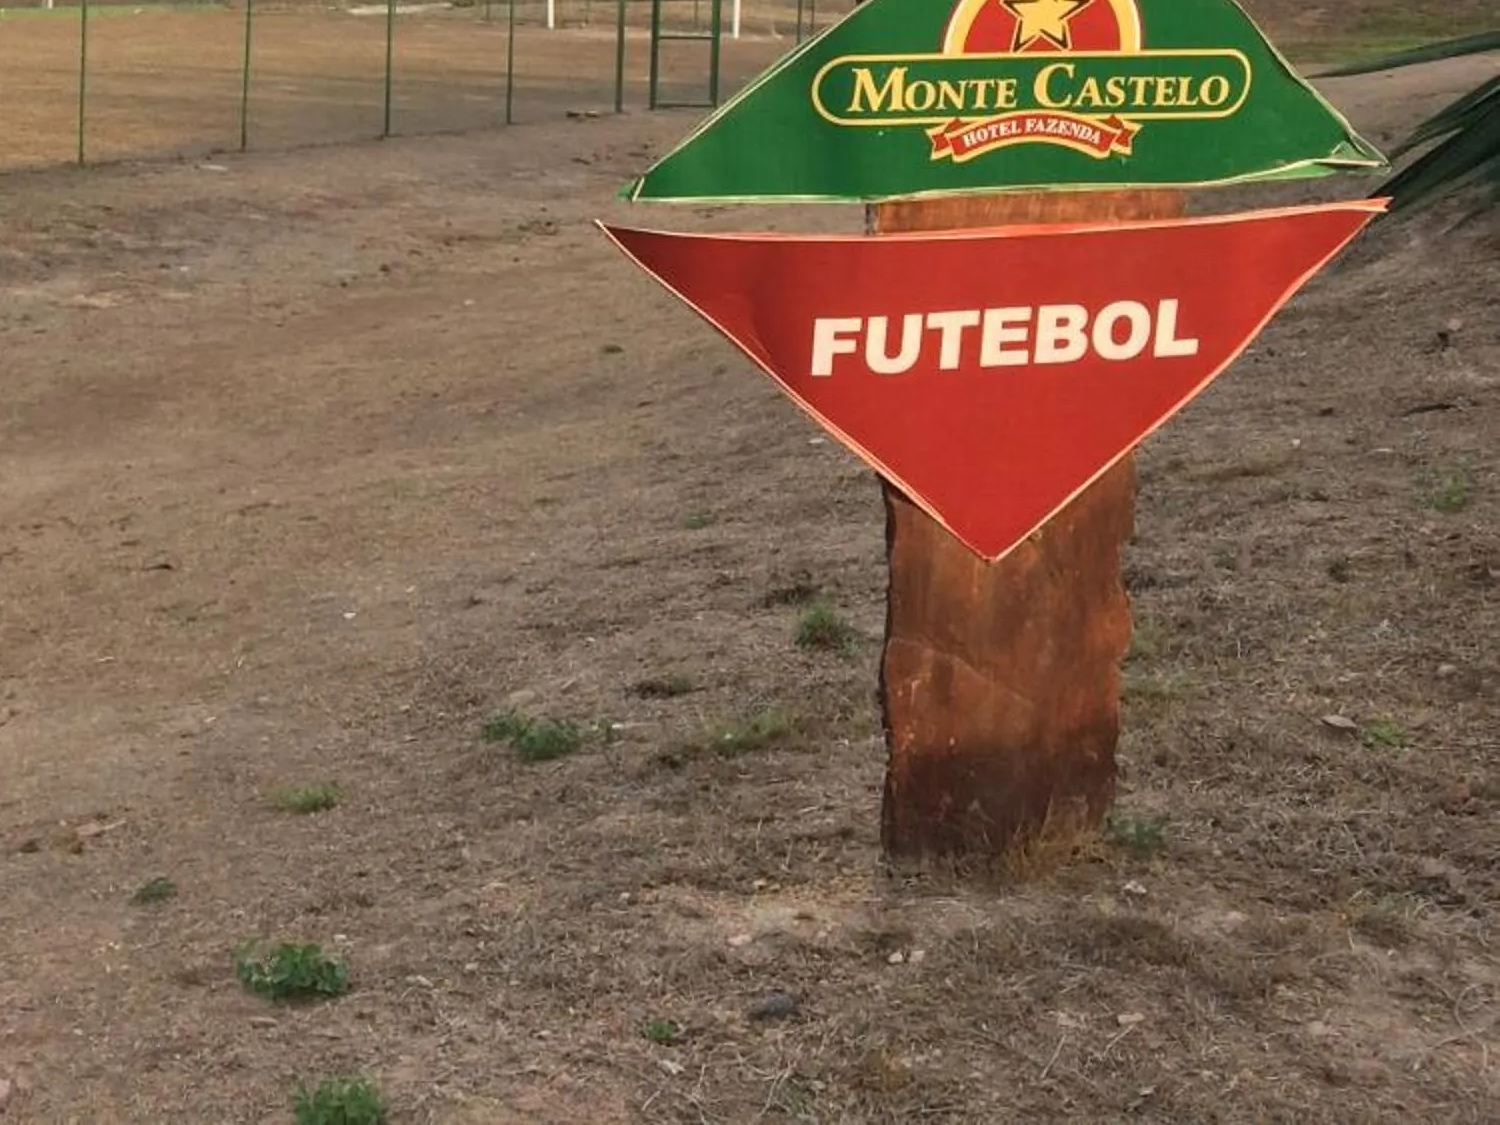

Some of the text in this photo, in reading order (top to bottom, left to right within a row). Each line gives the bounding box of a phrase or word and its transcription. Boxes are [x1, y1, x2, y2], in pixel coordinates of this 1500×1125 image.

[847, 62, 1230, 112] MONTE CASTELO
[963, 118, 1102, 148] HOTEL FAZENDA
[811, 298, 1199, 377] FUTEBOL
